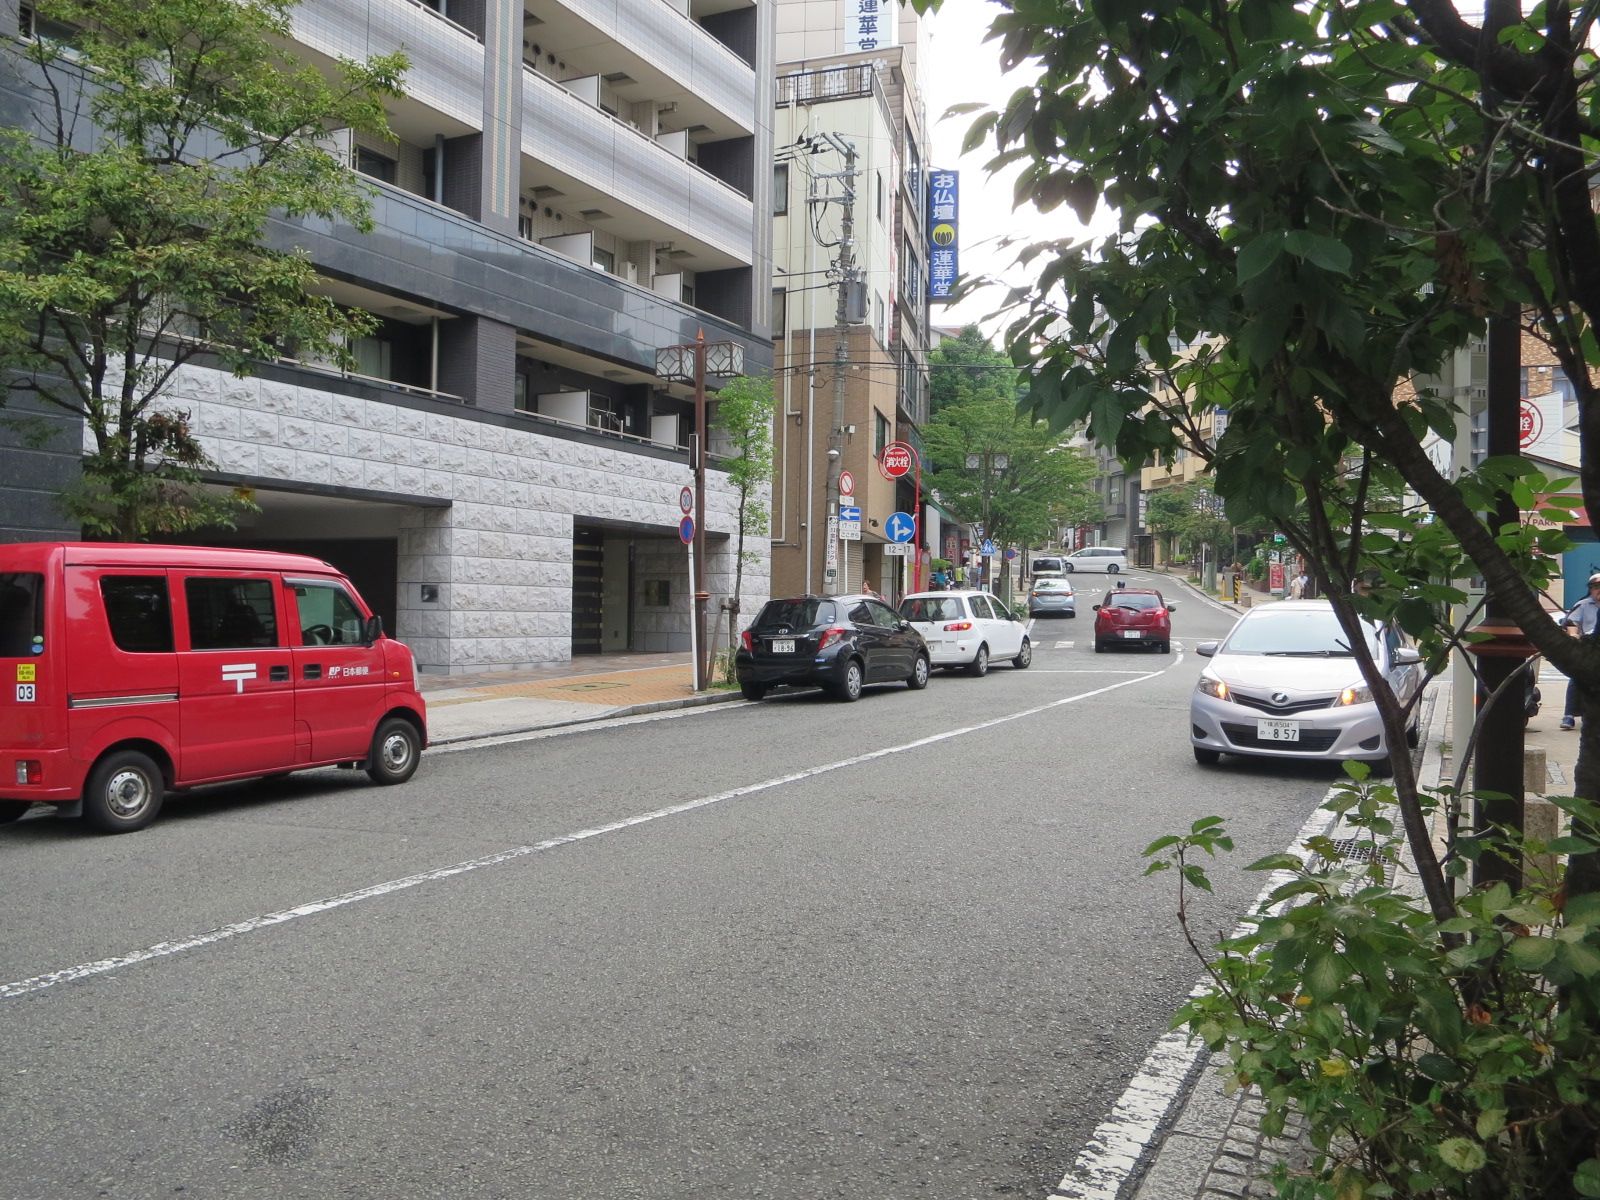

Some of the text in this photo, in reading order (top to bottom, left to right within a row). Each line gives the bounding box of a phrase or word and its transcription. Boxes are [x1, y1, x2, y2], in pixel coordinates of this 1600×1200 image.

[933, 174, 955, 220] お仏壇
[933, 250, 954, 297] 蓮華堂
[886, 456, 909, 468] 消火栓
[888, 545, 911, 554] 12-17
[342, 666, 369, 677] 日本郵便
[18, 685, 33, 700] 03
